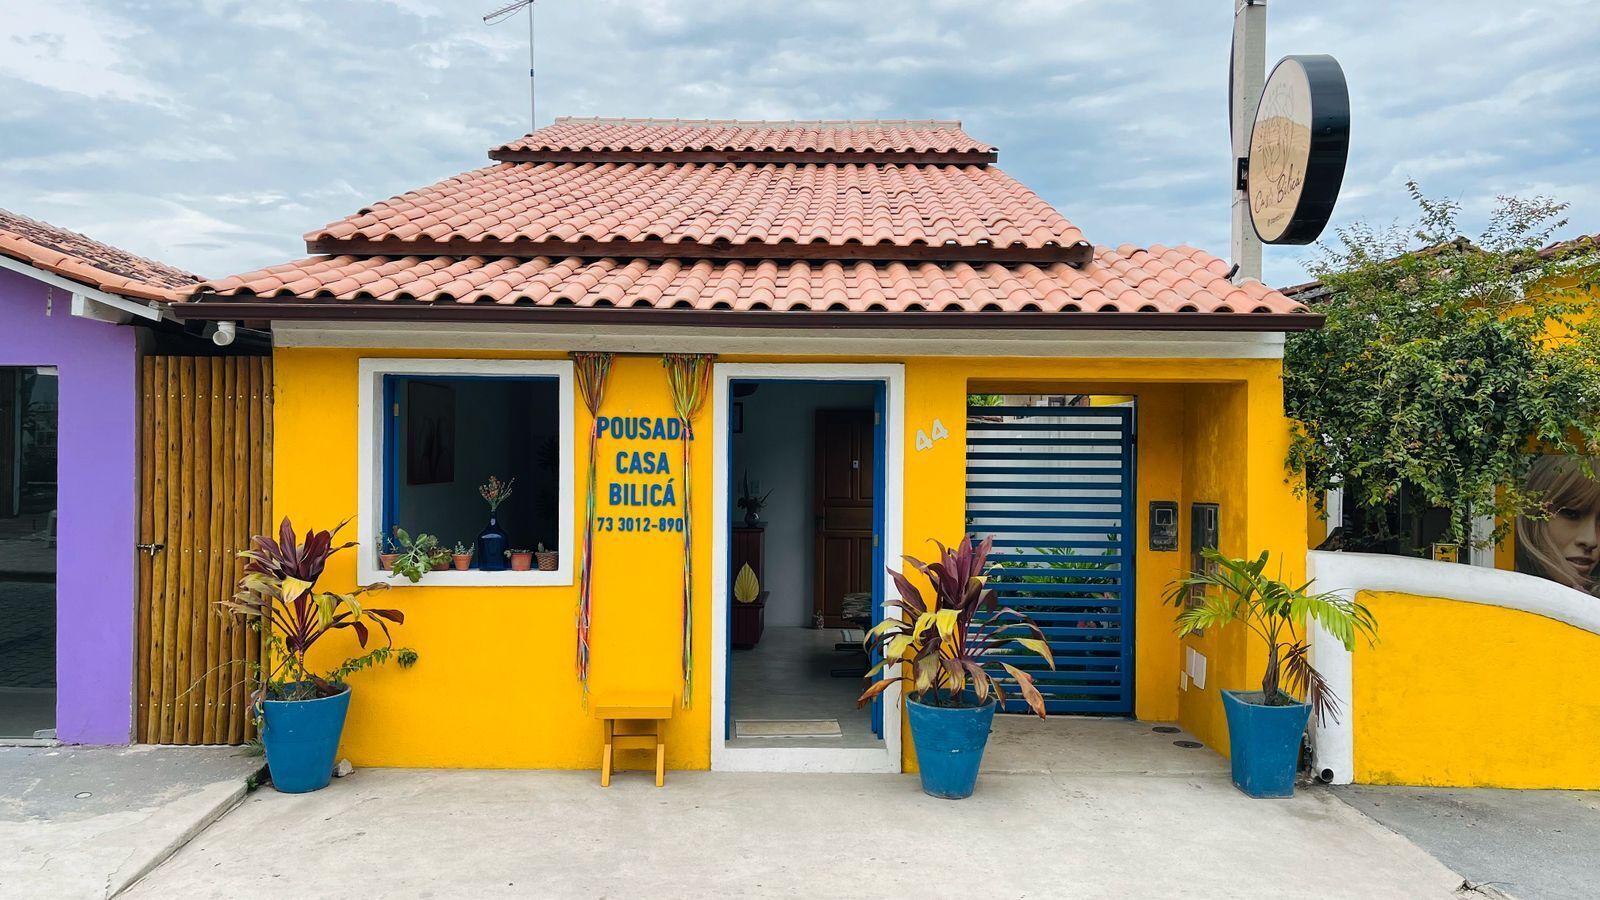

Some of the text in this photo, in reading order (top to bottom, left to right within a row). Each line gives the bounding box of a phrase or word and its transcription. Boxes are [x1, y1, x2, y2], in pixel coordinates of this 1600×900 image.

[915, 418, 949, 451] 44
[616, 451, 670, 474] CASA
[609, 478, 676, 506] BILICÁ
[597, 517, 684, 532] 73 3012-890
